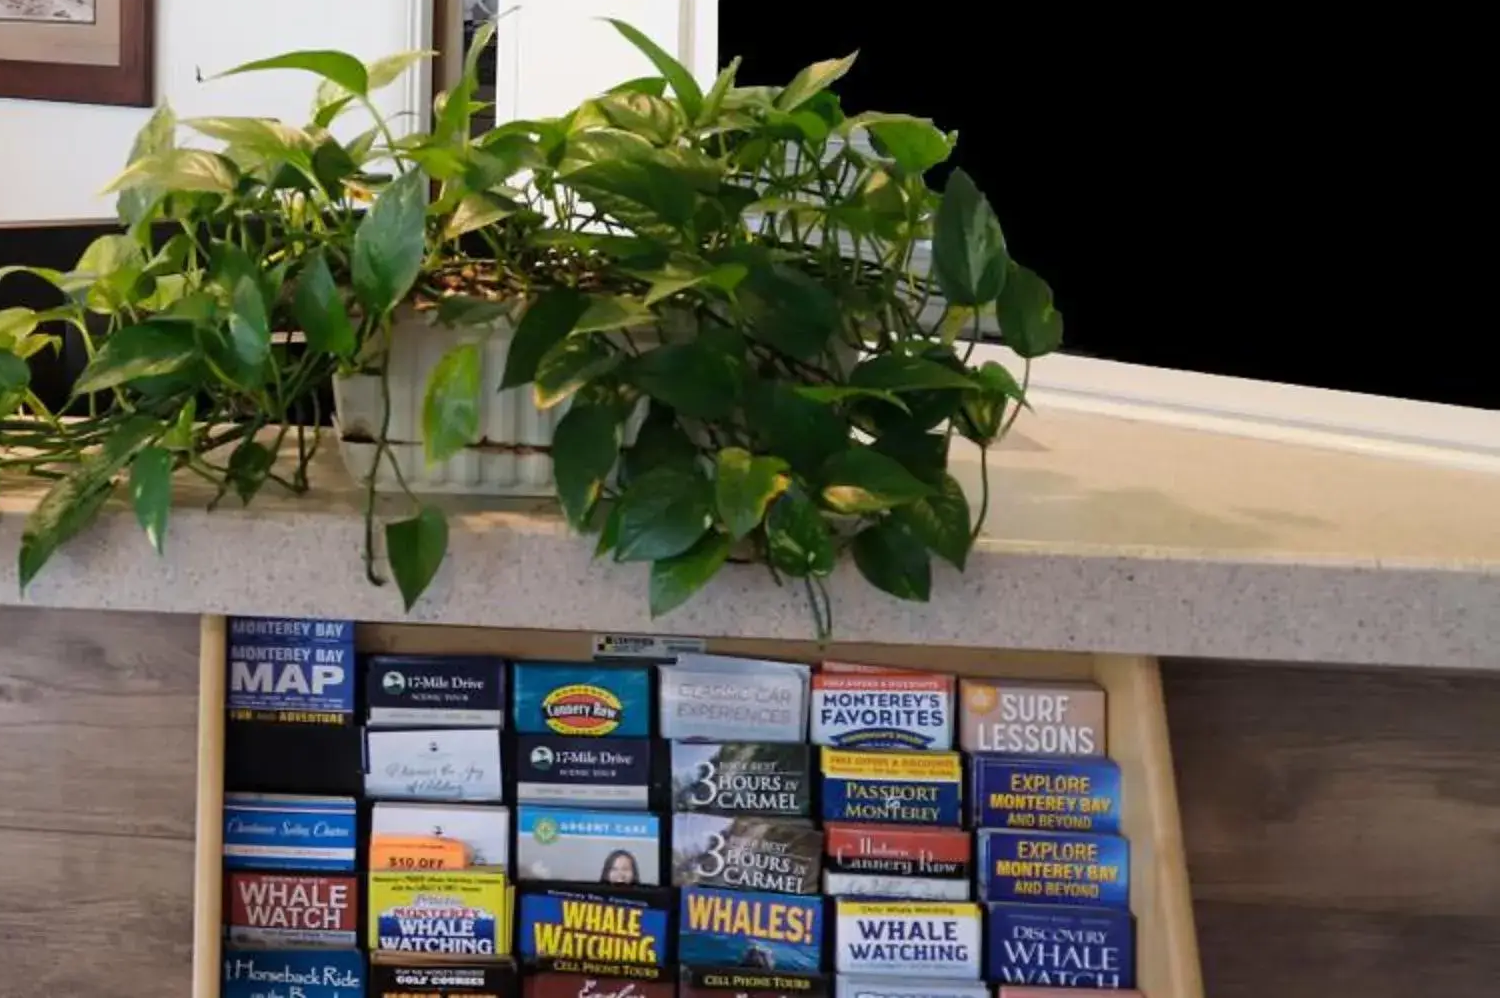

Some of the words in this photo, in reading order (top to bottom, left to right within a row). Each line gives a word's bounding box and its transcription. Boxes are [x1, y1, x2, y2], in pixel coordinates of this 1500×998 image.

[231, 620, 312, 637] MONTEREY
[315, 623, 344, 638] BAY
[231, 646, 311, 662] MONTEREY
[315, 649, 344, 663] BAY
[231, 661, 345, 695] MAP
[407, 675, 449, 689] 17-Mile
[451, 676, 484, 690] Drive
[755, 688, 792, 707] CAR
[822, 693, 940, 709] MONTEREY'S
[546, 702, 590, 719] Cannery
[593, 701, 618, 719] Row
[677, 702, 791, 724] EXPERIENCES
[821, 709, 945, 727] FAVORITES
[1000, 694, 1070, 723] SURF
[977, 722, 1095, 753] LESSONS
[555, 751, 597, 765] 17-Mile
[599, 752, 634, 766] Drive
[690, 761, 717, 805] 3
[718, 774, 782, 791] HOURS
[846, 781, 940, 802] PASSPORT
[1011, 773, 1091, 795] EXPLORE
[717, 791, 801, 810] CARMEL
[990, 793, 1077, 811] MONTEREY
[1079, 798, 1112, 813] BAY
[845, 802, 941, 821] MONTEREY
[1008, 813, 1036, 826] AND
[1039, 814, 1092, 829] BEYOND
[696, 832, 725, 877] 3
[837, 843, 913, 875] Cannery
[919, 849, 957, 874] Row
[1016, 841, 1099, 862] EXPLORE
[418, 857, 445, 869] OFF
[725, 850, 790, 874] HOURS
[996, 859, 1085, 880] MONTEREY
[1087, 865, 1119, 883] BAY
[723, 867, 806, 895] CARMEL
[1014, 880, 1042, 895] AND
[1045, 882, 1099, 899] BEYOND
[239, 881, 349, 909] WHALE
[246, 905, 341, 930] WATCH
[398, 917, 476, 937] WHALE
[563, 901, 643, 937] WHALE
[687, 893, 814, 945] WHALES!
[857, 920, 958, 941] WHALE
[1011, 925, 1108, 944] DISCOVERY
[379, 935, 493, 955] WATCHING
[533, 922, 658, 963] WATCHING
[849, 944, 969, 962] WATCHING
[1003, 939, 1120, 971] WHALE
[234, 958, 321, 985] Horseback
[322, 965, 361, 988] Ride
[552, 960, 581, 973] CELL
[581, 961, 622, 976] PHONE
[623, 964, 660, 979] TOURS
[395, 975, 428, 985] GOLF
[704, 975, 730, 986] CELL
[732, 975, 771, 988] PHONE
[772, 977, 811, 990] TOURS
